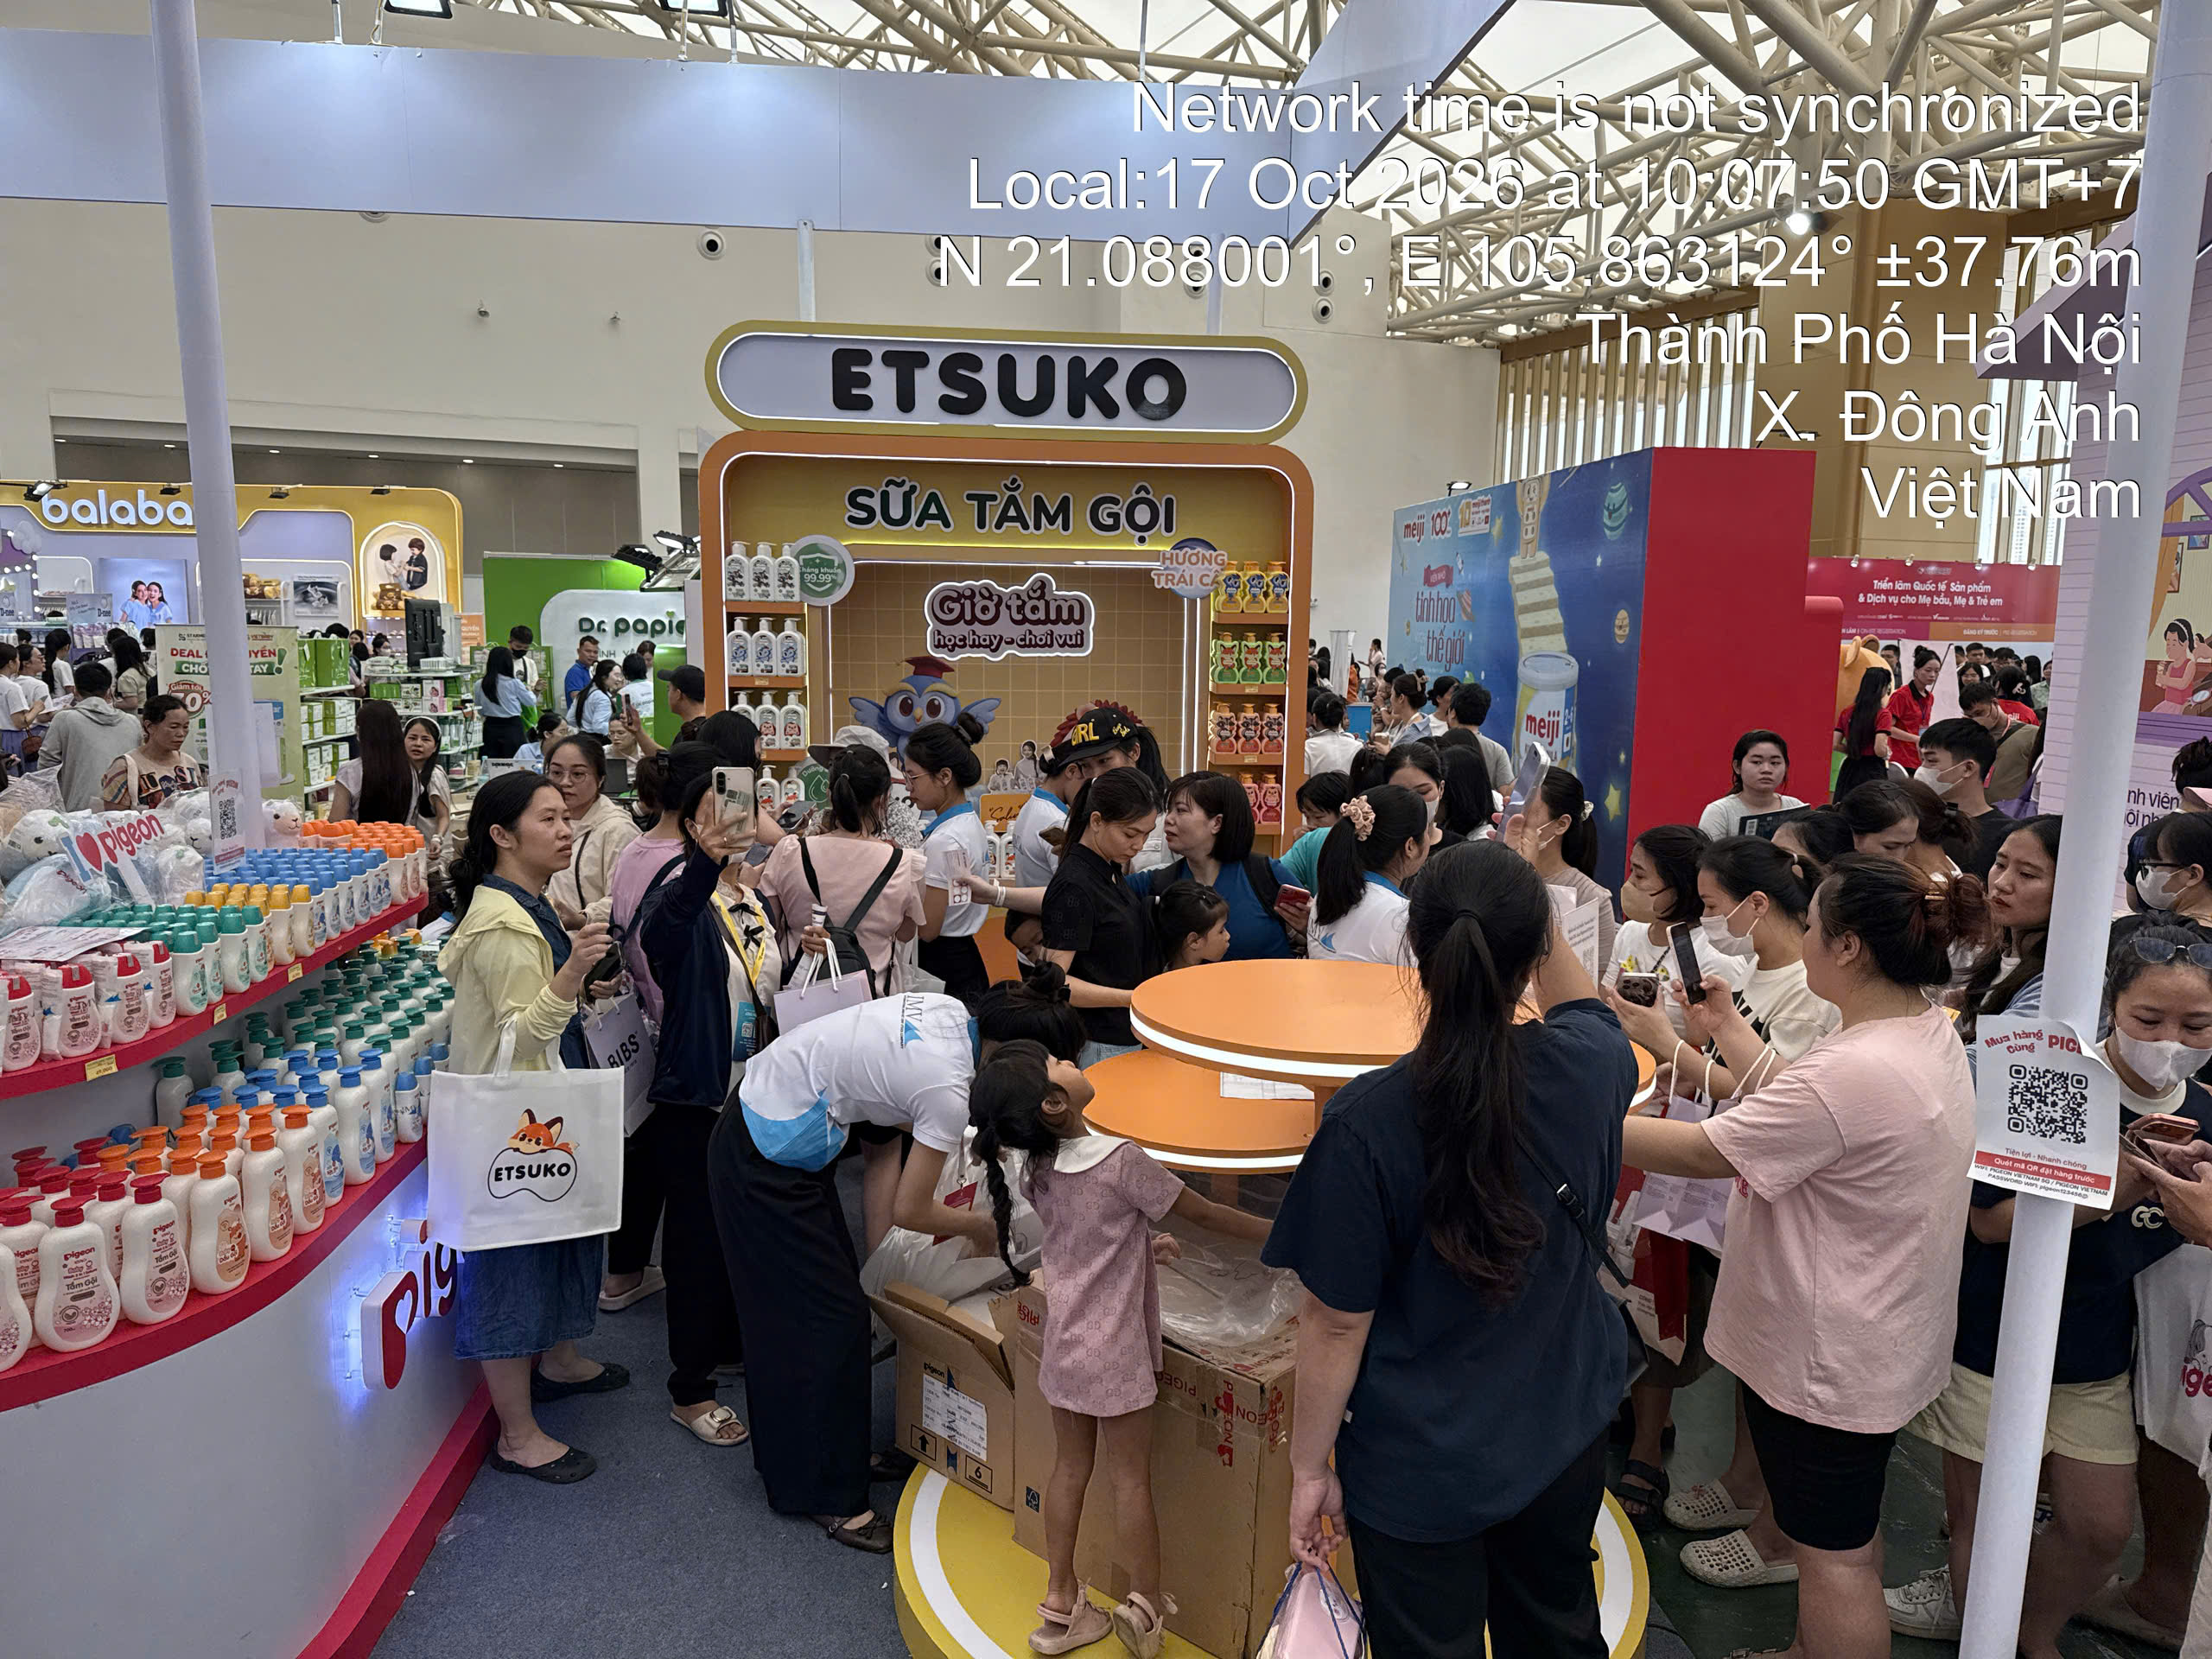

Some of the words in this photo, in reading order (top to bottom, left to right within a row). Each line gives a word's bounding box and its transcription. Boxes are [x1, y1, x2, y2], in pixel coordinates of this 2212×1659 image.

[831, 347, 1187, 421] ETSUKO
[41, 489, 194, 526] balaba
[846, 476, 952, 531] SỮA
[964, 475, 1071, 533] TẮM
[1088, 482, 1176, 546] GỘI
[1403, 514, 1425, 543] meiji
[1160, 550, 1227, 567] HƯƠNG
[798, 567, 819, 575] háng
[804, 573, 837, 583] 99.99%
[1153, 569, 1193, 588] TRÁI
[1198, 569, 1224, 588] CÂ
[1872, 577, 1893, 590] Triển
[1913, 579, 1936, 592] Quốc
[1949, 581, 1966, 592] Sản
[1967, 580, 1992, 594] phẩm
[932, 587, 1002, 626] Giờ
[1006, 580, 1085, 626] tắm
[1415, 590, 1434, 623] tinh
[1858, 594, 1865, 603] &
[1866, 594, 1886, 606] Dịch
[1888, 596, 1898, 606] vụ
[1900, 594, 1916, 604] cho
[1918, 596, 1930, 606] Mẹ
[1954, 596, 1966, 606] Mẹ
[1967, 596, 1974, 605] &
[1976, 594, 1988, 606] Trẻ
[579, 617, 607, 632] Dr.
[933, 629, 966, 652] học
[968, 629, 1003, 652] hay
[1016, 628, 1053, 649] chơi
[1055, 628, 1084, 649] vui
[1426, 625, 1445, 663] thế
[1444, 629, 1466, 672] giới
[170, 648, 203, 658] DEAL
[181, 661, 208, 674] CHỐ
[1525, 710, 1560, 747] meiji
[2149, 791, 2179, 810] viên
[2125, 808, 2139, 828] ội
[97, 814, 165, 864] pigeon
[1984, 1035, 2011, 1048] Mua
[2013, 1029, 2044, 1042] hàng
[2048, 1034, 2082, 1054] PIG
[2005, 1147, 2020, 1158] Tiện
[2037, 1154, 2062, 1165] Nhanh
[2063, 1159, 2088, 1170] chóng
[494, 1162, 571, 1182] ETSUKO
[1987, 1173, 2023, 1185] PASSWORD
[2013, 1160, 2025, 1169] mã
[2026, 1164, 2038, 1173] QR
[2054, 1169, 2073, 1180] hàng
[1989, 1167, 2012, 1177] PIGEON
[2013, 1172, 2040, 1182] VIETNAM
[2056, 1180, 2079, 1191] PIGEON
[2080, 1185, 2108, 1197] VIETNAM
[153, 1219, 175, 1236] pigeon
[63, 1247, 96, 1261] pigeon
[66, 1281, 84, 1291] Tắm
[85, 1276, 98, 1286] Gội
[379, 1219, 459, 1390] pig
[924, 1362, 945, 1378] pigeon
[975, 1465, 982, 1479] 6
